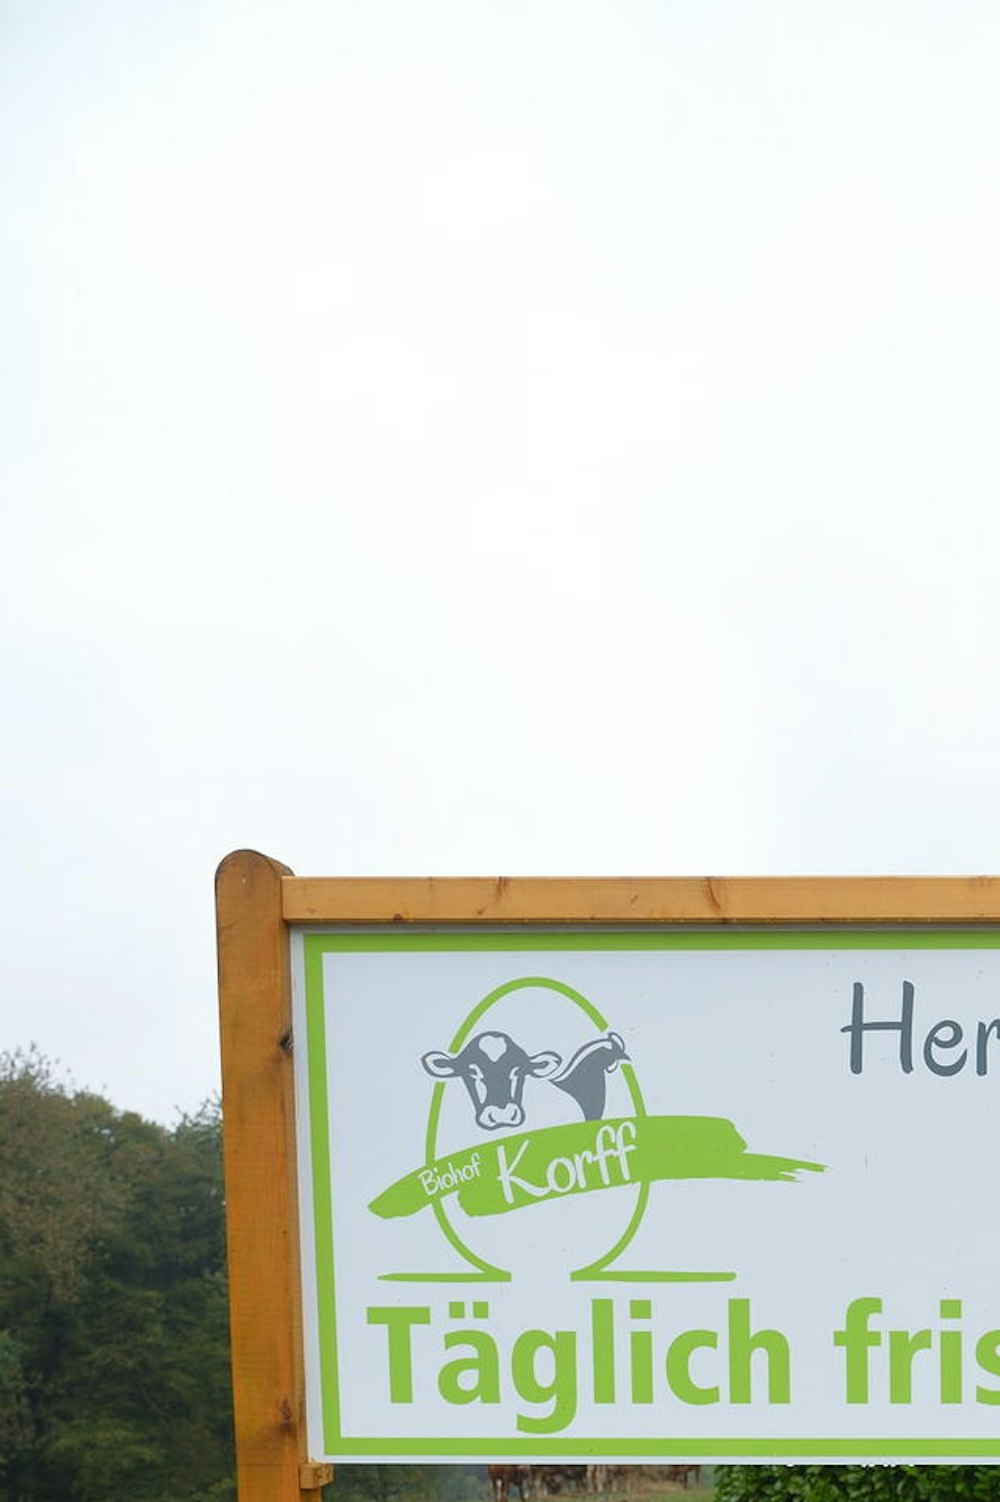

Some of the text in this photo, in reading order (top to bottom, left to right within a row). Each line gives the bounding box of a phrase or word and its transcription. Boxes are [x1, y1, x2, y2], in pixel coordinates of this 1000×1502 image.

[418, 1121, 638, 1204] Biohof Korff
[366, 1298, 791, 1435] Täglich
